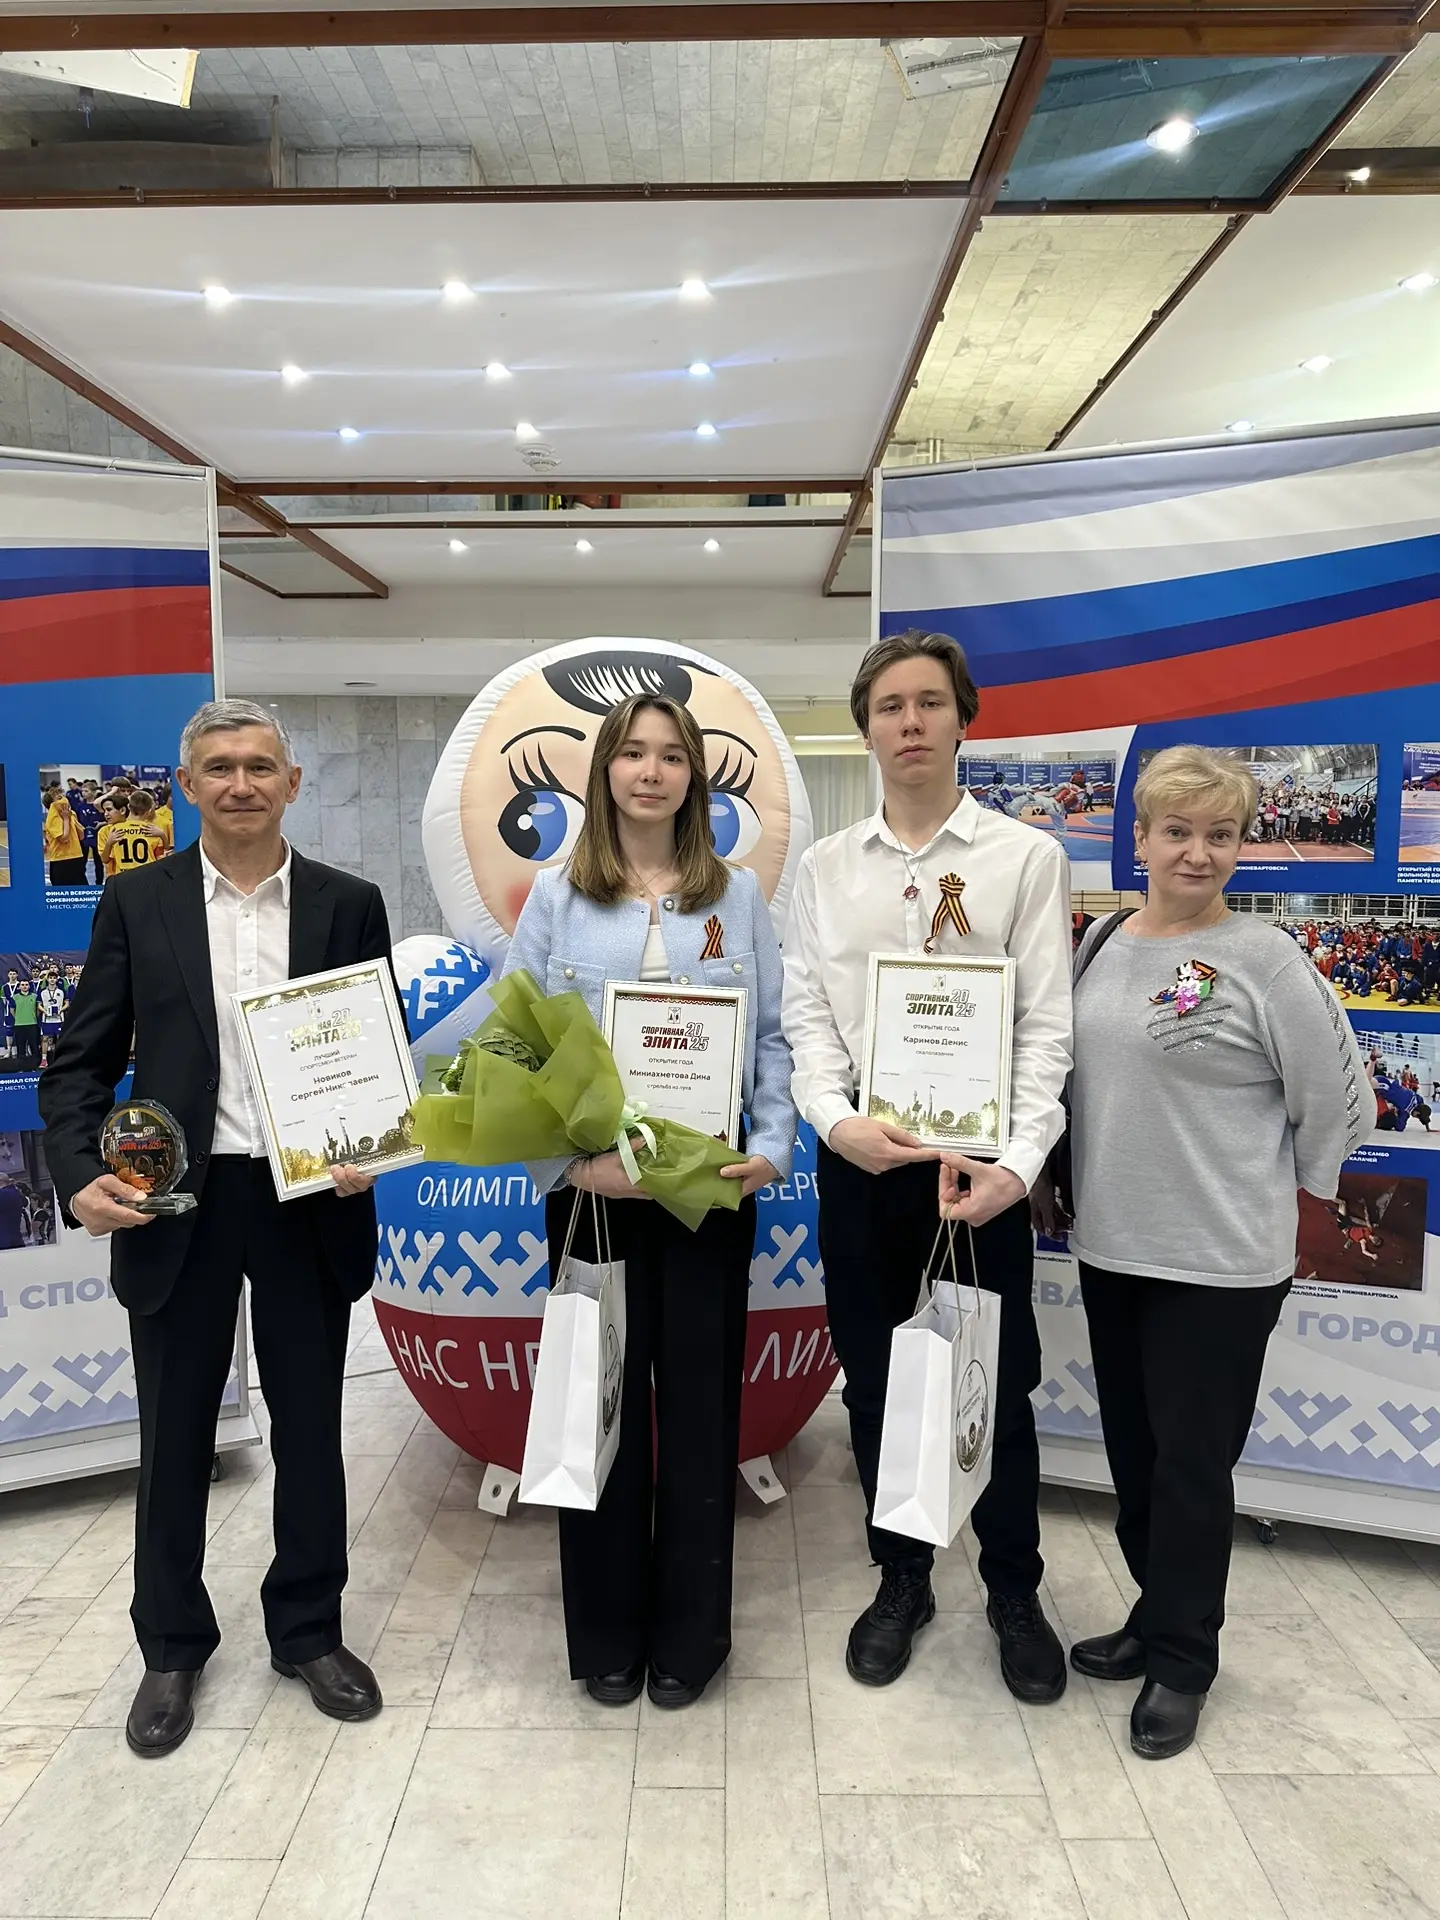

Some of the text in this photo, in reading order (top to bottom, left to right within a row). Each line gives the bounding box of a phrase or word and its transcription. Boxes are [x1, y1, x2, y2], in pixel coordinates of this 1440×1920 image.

[118, 838, 148, 863] 10
[904, 988, 970, 1004] СПОРТИВНАЯ 20
[906, 1002, 977, 1018] ЭЛИТА 25
[641, 1021, 704, 1038] СПОРТИВНАЯ 20
[912, 1023, 944, 1031] ОТКРЫТИЕ
[642, 1035, 710, 1052] ЭЛИТА 25
[903, 1035, 969, 1047] Каримов Денис
[648, 1057, 678, 1065] ОТКРЫТИЕ
[313, 1070, 353, 1085] Новиков
[629, 1069, 711, 1081] Миниахметова Дина
[291, 1087, 325, 1102] Сергей
[1317, 1286, 1341, 1294] ГОРОДА
[1342, 1289, 1399, 1299] НИЖНЕВАРТОВСКА
[1297, 1310, 1440, 1357] ГОРОД
[391, 1326, 469, 1389] НАС
